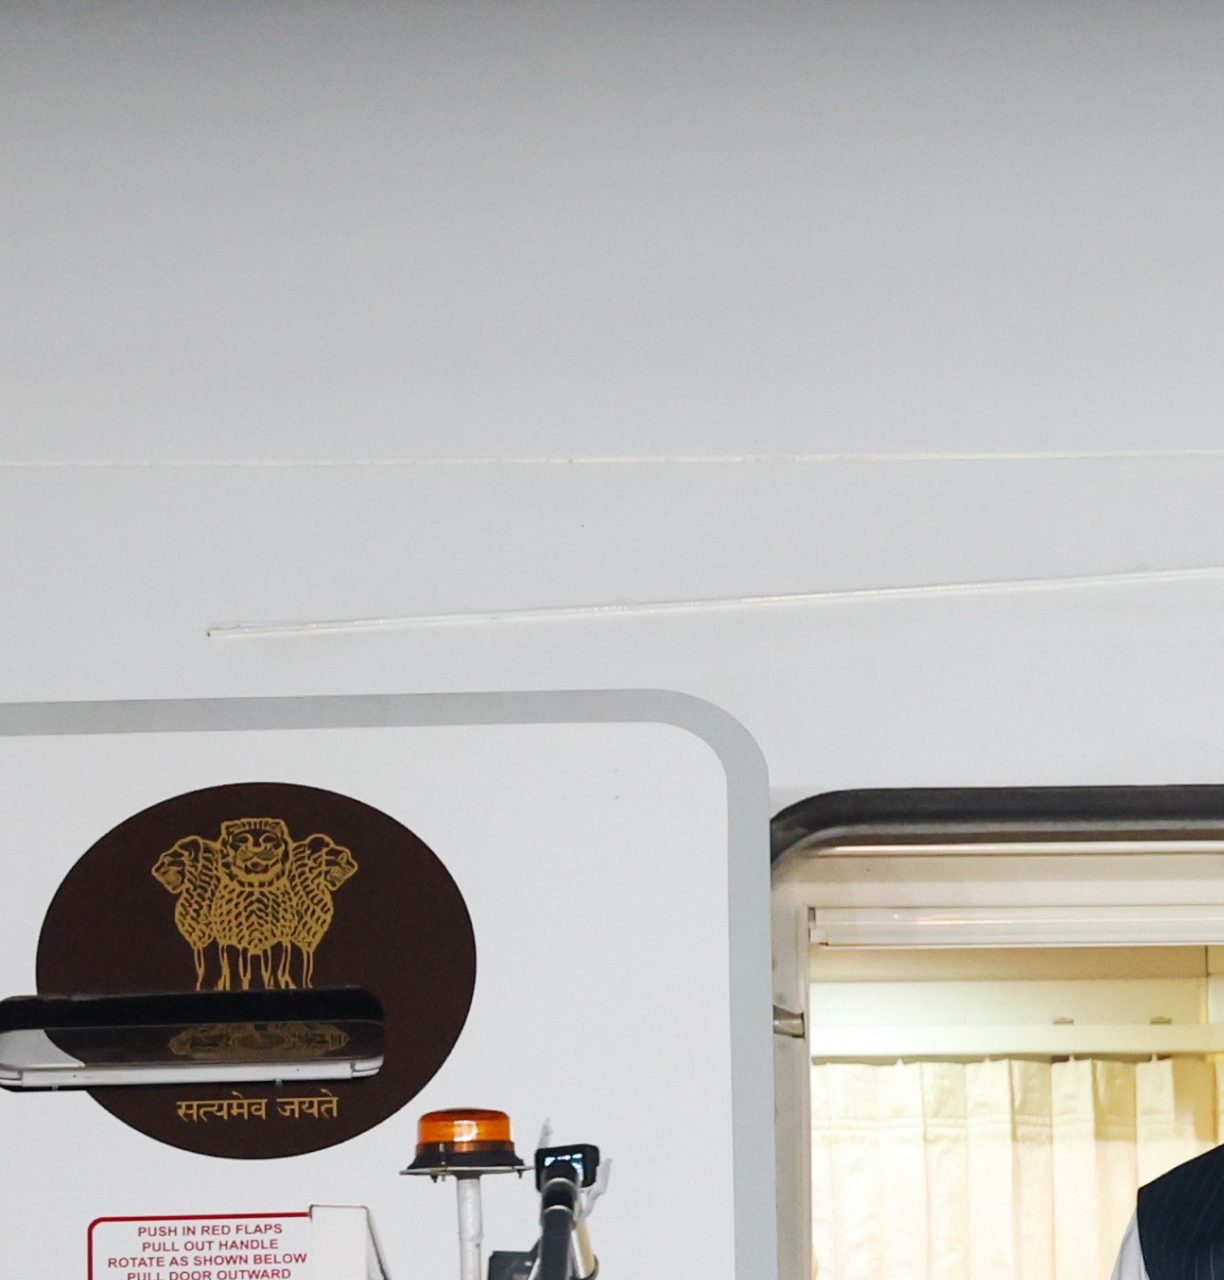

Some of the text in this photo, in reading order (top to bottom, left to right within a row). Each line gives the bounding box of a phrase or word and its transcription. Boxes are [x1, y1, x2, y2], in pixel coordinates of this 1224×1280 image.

[176, 1088, 338, 1122] सत्यमेव जयते
[138, 1223, 283, 1237] PUSH IN RED FLAPS
[142, 1239, 279, 1252] PULL OUT HANDLE
[108, 1253, 307, 1268] ROTATE AS SHOWN BELOW
[216, 1269, 292, 1280] OUTWARD
